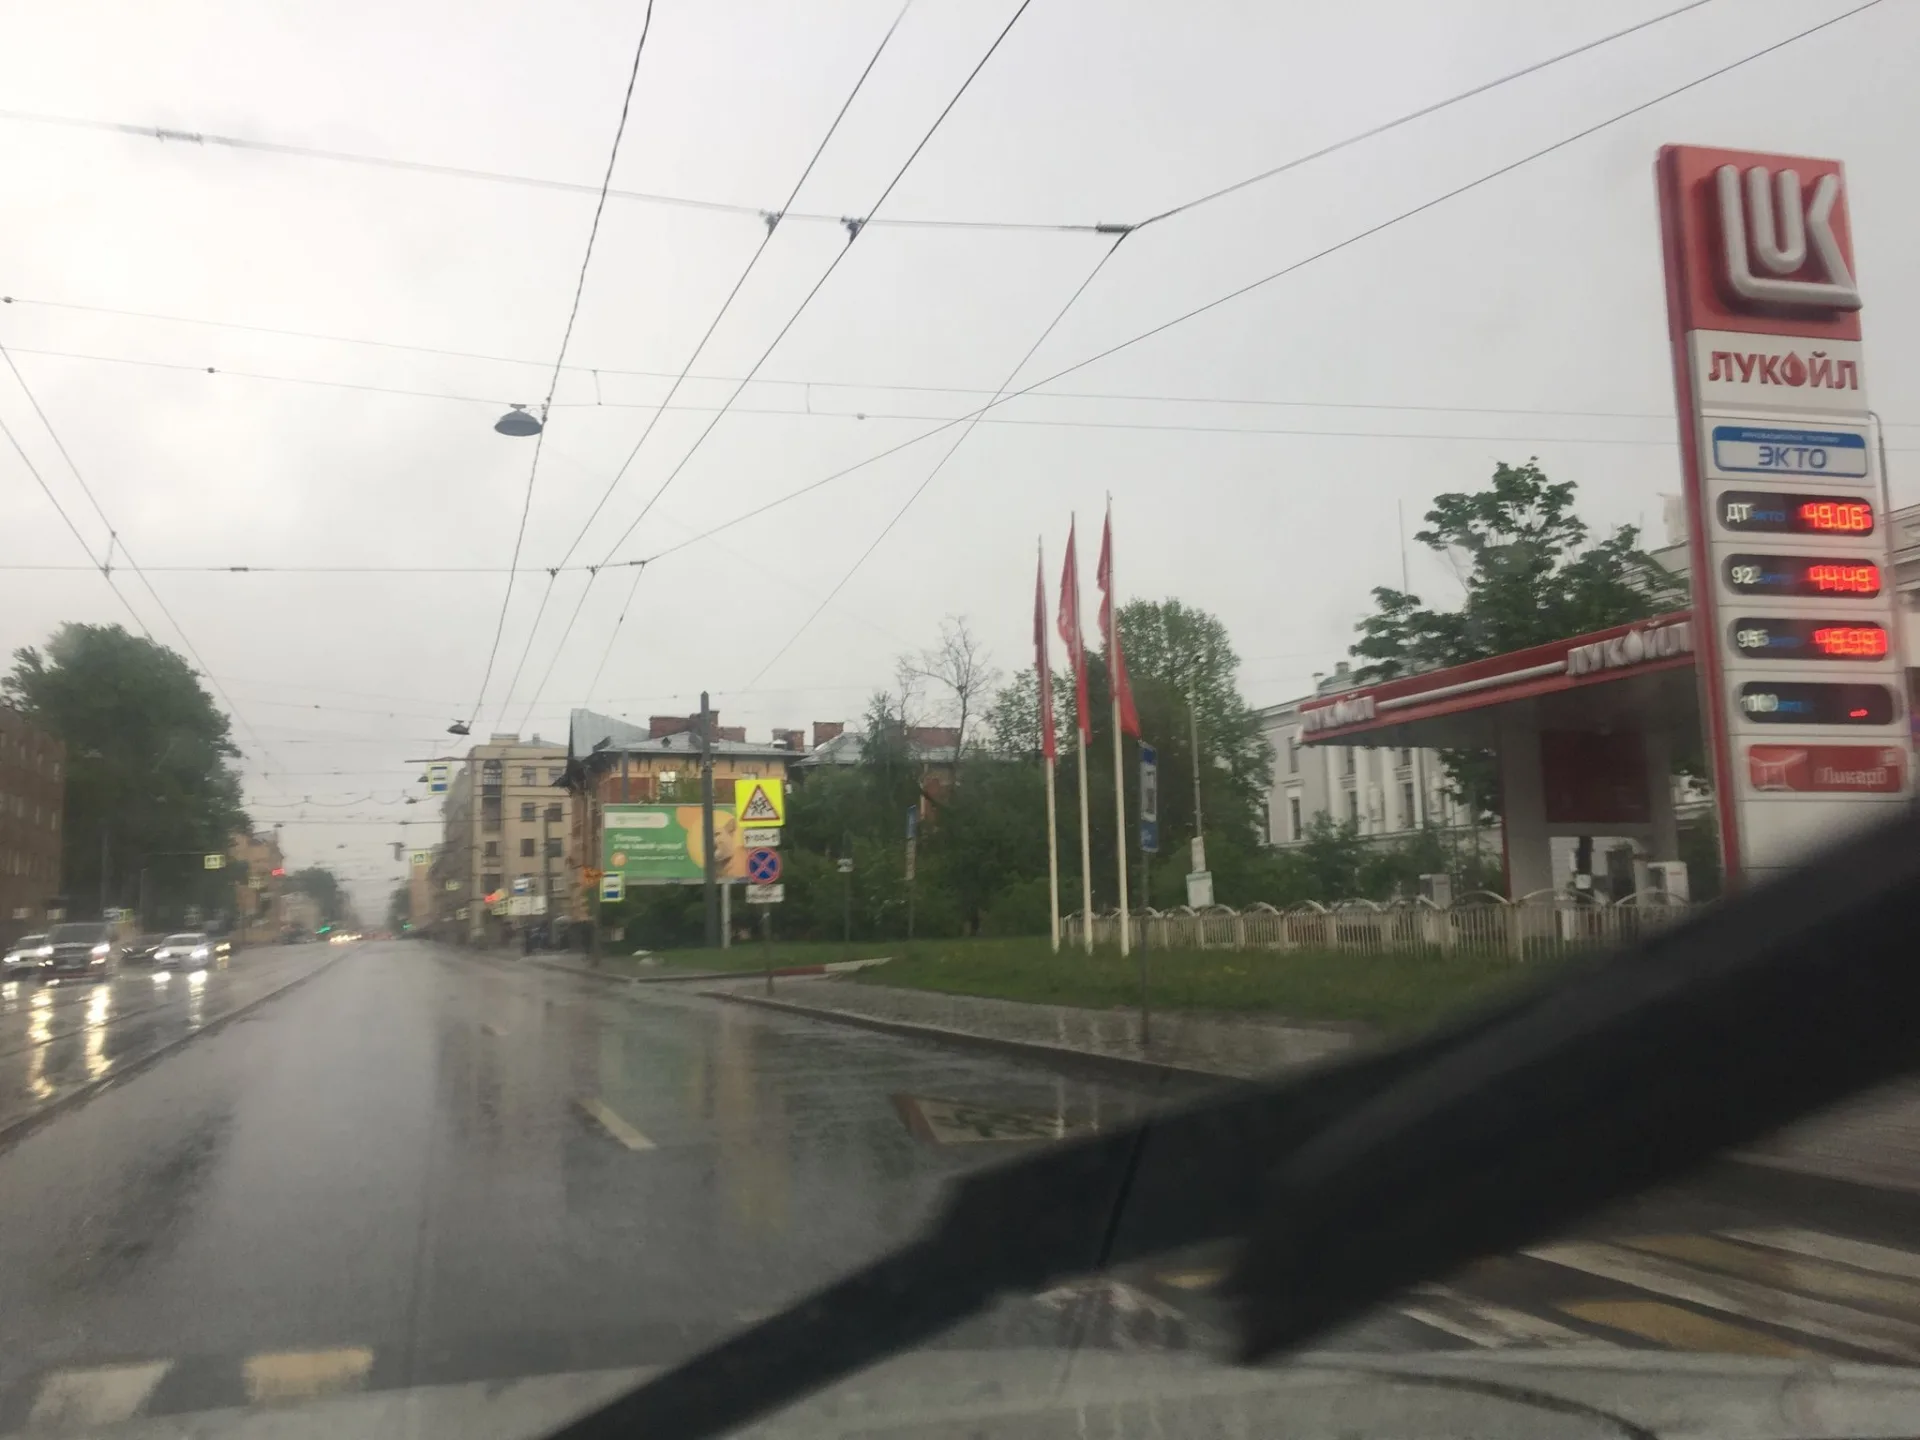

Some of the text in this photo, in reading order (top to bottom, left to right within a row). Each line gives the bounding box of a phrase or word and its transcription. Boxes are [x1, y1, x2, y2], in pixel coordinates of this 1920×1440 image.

[1708, 350, 1859, 390] ЛУКОЙЛ
[1758, 446, 1827, 469] ЭКТО
[1726, 503, 1752, 522] ДТ
[1731, 565, 1759, 584] 92
